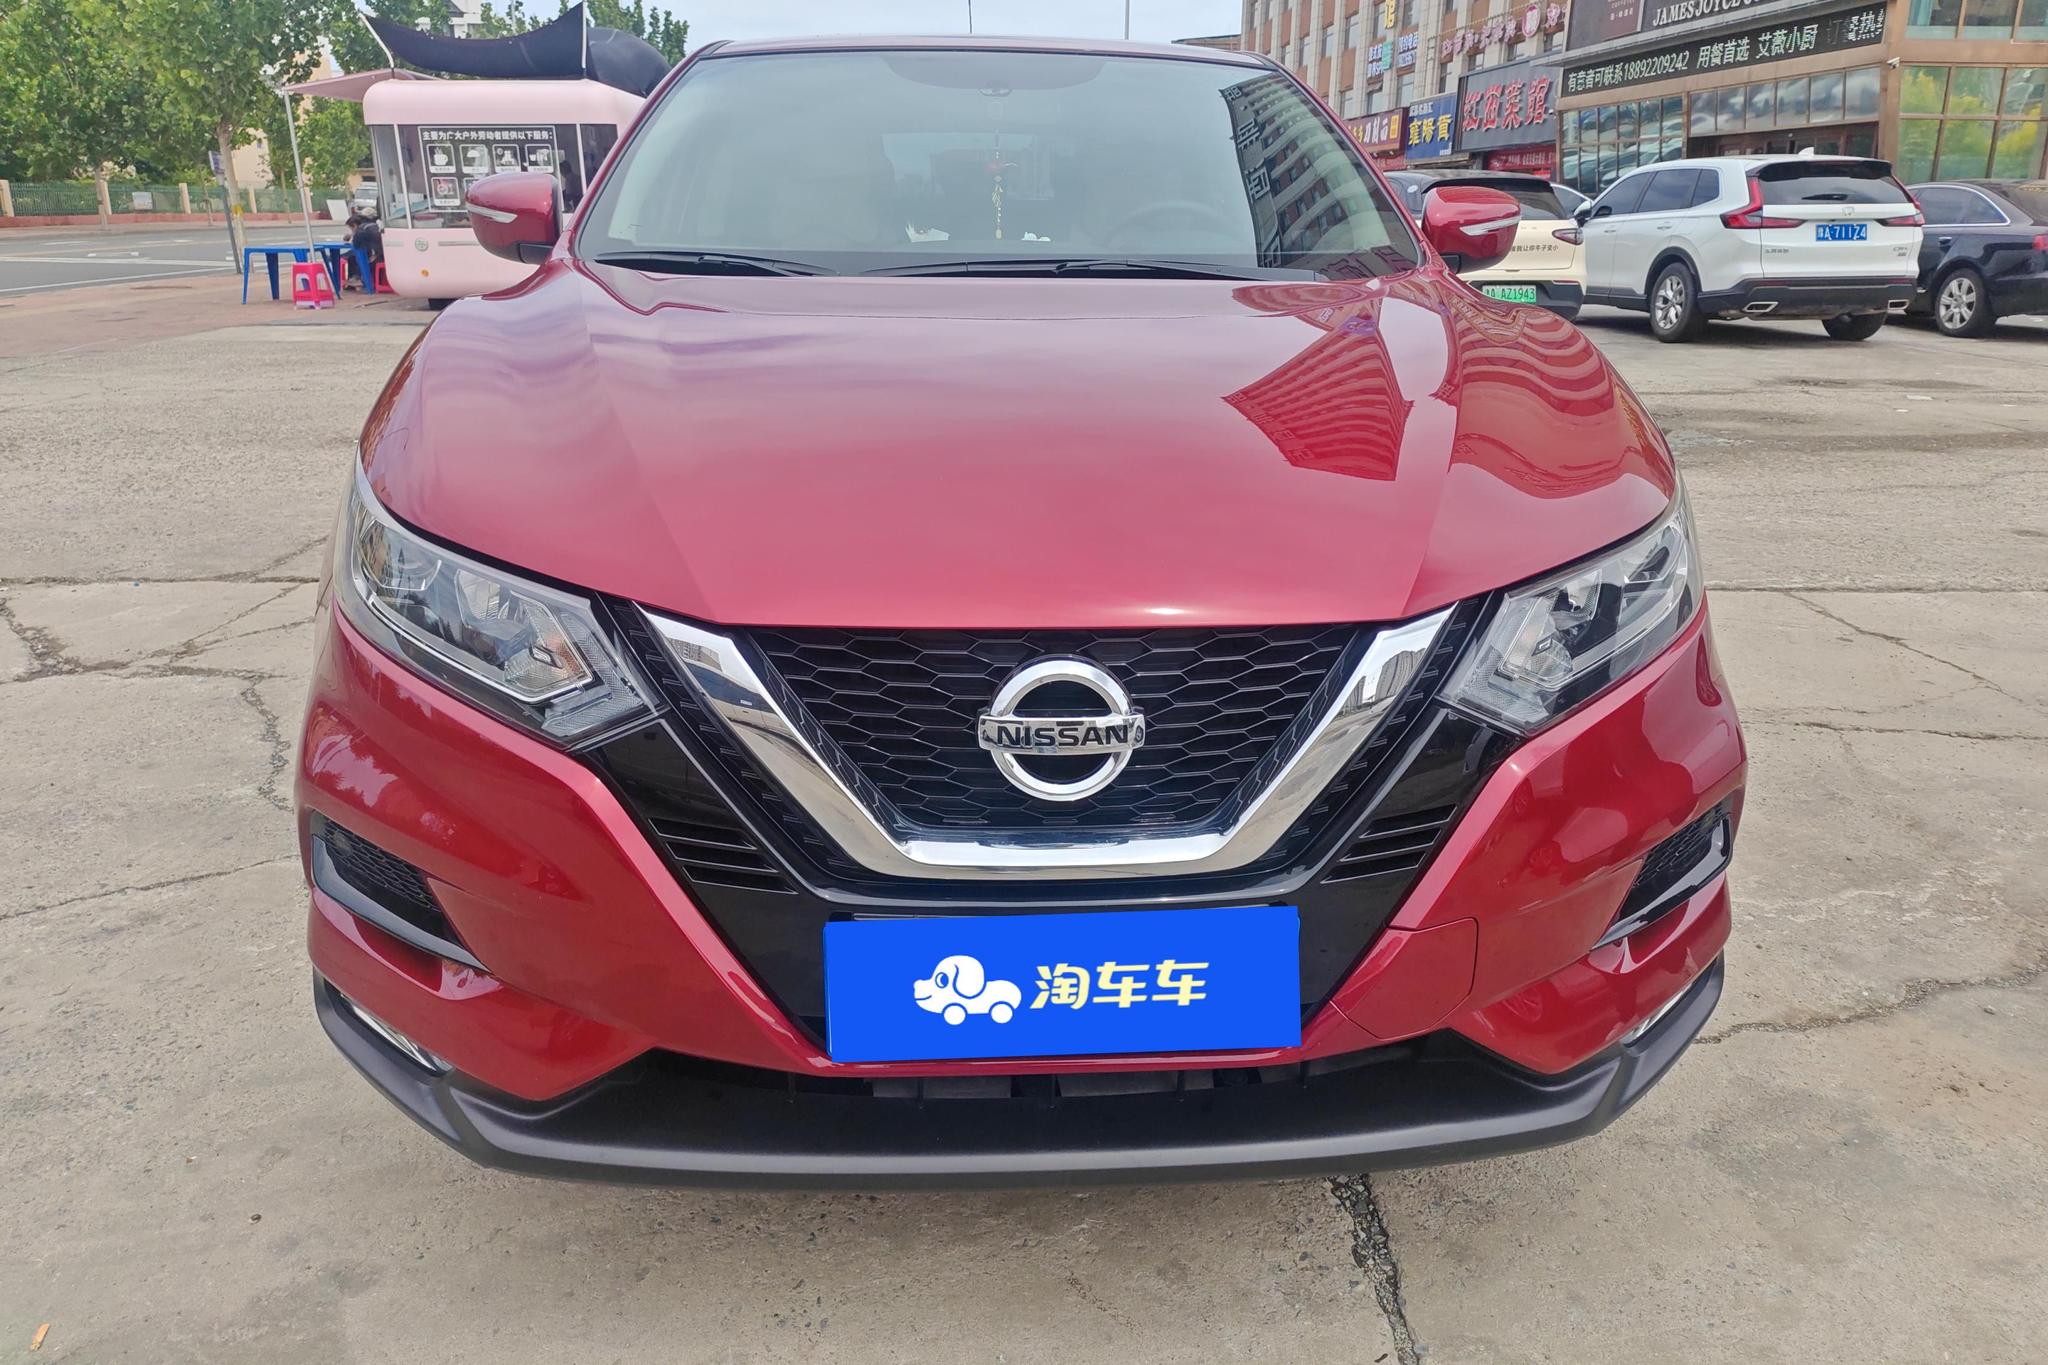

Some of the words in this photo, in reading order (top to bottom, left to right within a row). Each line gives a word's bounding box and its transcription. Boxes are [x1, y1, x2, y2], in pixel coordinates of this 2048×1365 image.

[1652, 1, 1694, 27] JAMES
[1696, 36, 1750, 69] 用餐首选
[1755, 24, 1818, 59] 艾薇小厨
[997, 724, 1129, 747] NISSAN
